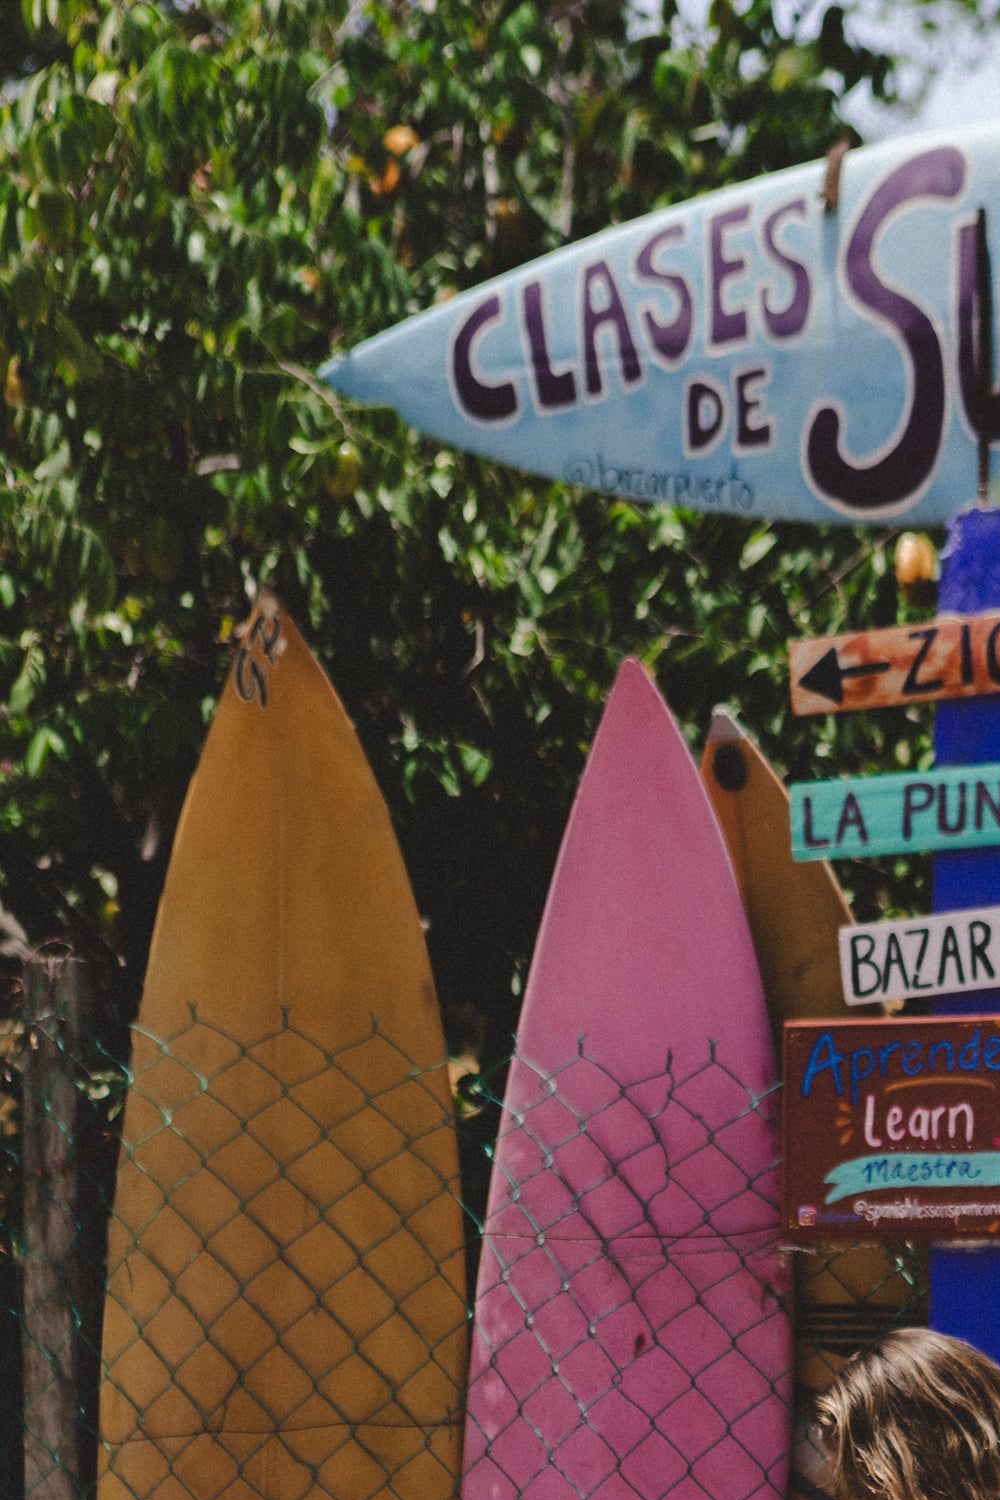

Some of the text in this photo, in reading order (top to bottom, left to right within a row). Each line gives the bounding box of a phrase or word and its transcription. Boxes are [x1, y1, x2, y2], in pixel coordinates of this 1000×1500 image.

[450, 200, 814, 426] CLASES
[685, 367, 774, 455] DE
[802, 792, 869, 849] LA
[849, 919, 996, 999] BAZAR
[863, 1094, 975, 1149] Learn
